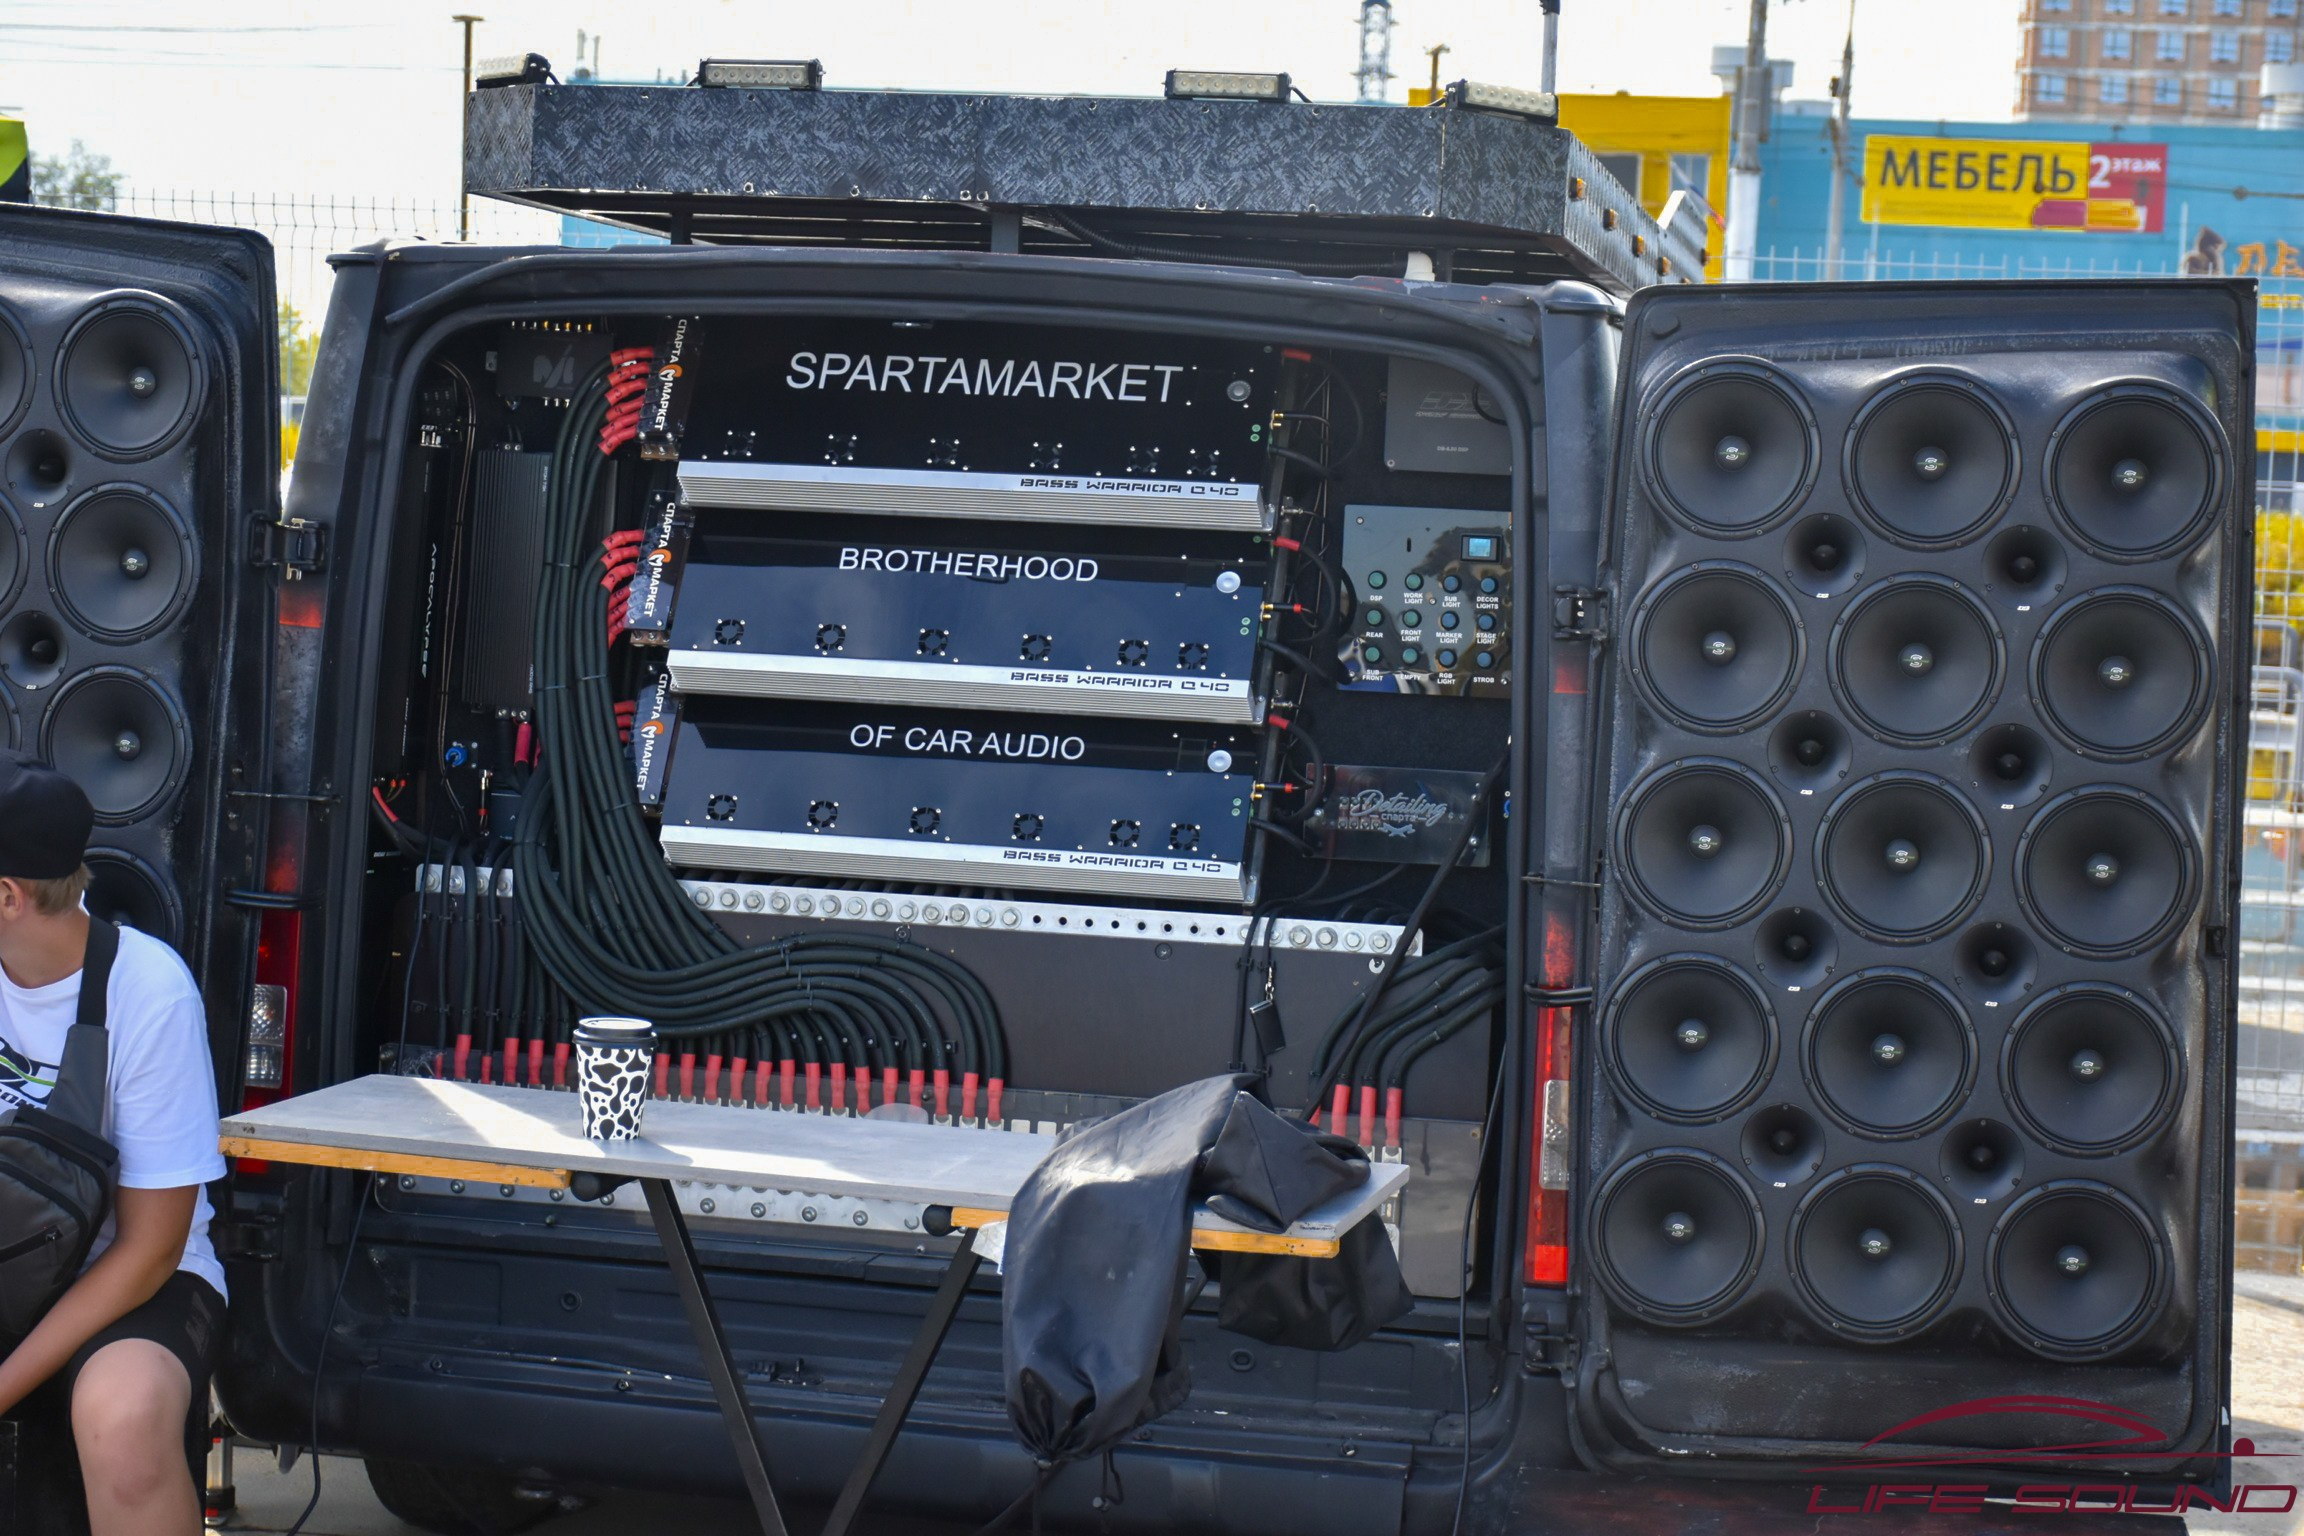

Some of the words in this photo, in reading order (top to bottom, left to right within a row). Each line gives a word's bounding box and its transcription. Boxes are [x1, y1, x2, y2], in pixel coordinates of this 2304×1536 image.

[1880, 148, 2076, 194] МЕБЕЛЬ
[2089, 155, 2111, 188] 2
[2111, 157, 2161, 173] этаж
[669, 319, 688, 364] СПАРТА
[786, 352, 1184, 403] SPARTAMARKET
[654, 382, 674, 431] МАРКЕТ
[1019, 478, 1078, 489] BASS
[1085, 480, 1182, 495] WARRIOR
[658, 502, 676, 548] СПАРТА
[838, 547, 1098, 582] BROTHERHOOD
[644, 567, 663, 617] МАРКЕТ
[650, 673, 669, 720] СПАРТА
[1010, 672, 1069, 683] BASS
[1077, 675, 1173, 689] WARRIOR
[1437, 677, 1456, 685] LIGHT
[850, 724, 896, 748] OF
[905, 727, 973, 754] CAR
[979, 732, 1085, 760] AUDIO
[636, 739, 655, 791] МАРКЕТ
[1350, 789, 1448, 828] Detailing
[1003, 850, 1062, 862] BASS
[1069, 853, 1164, 869] WARRIOR
